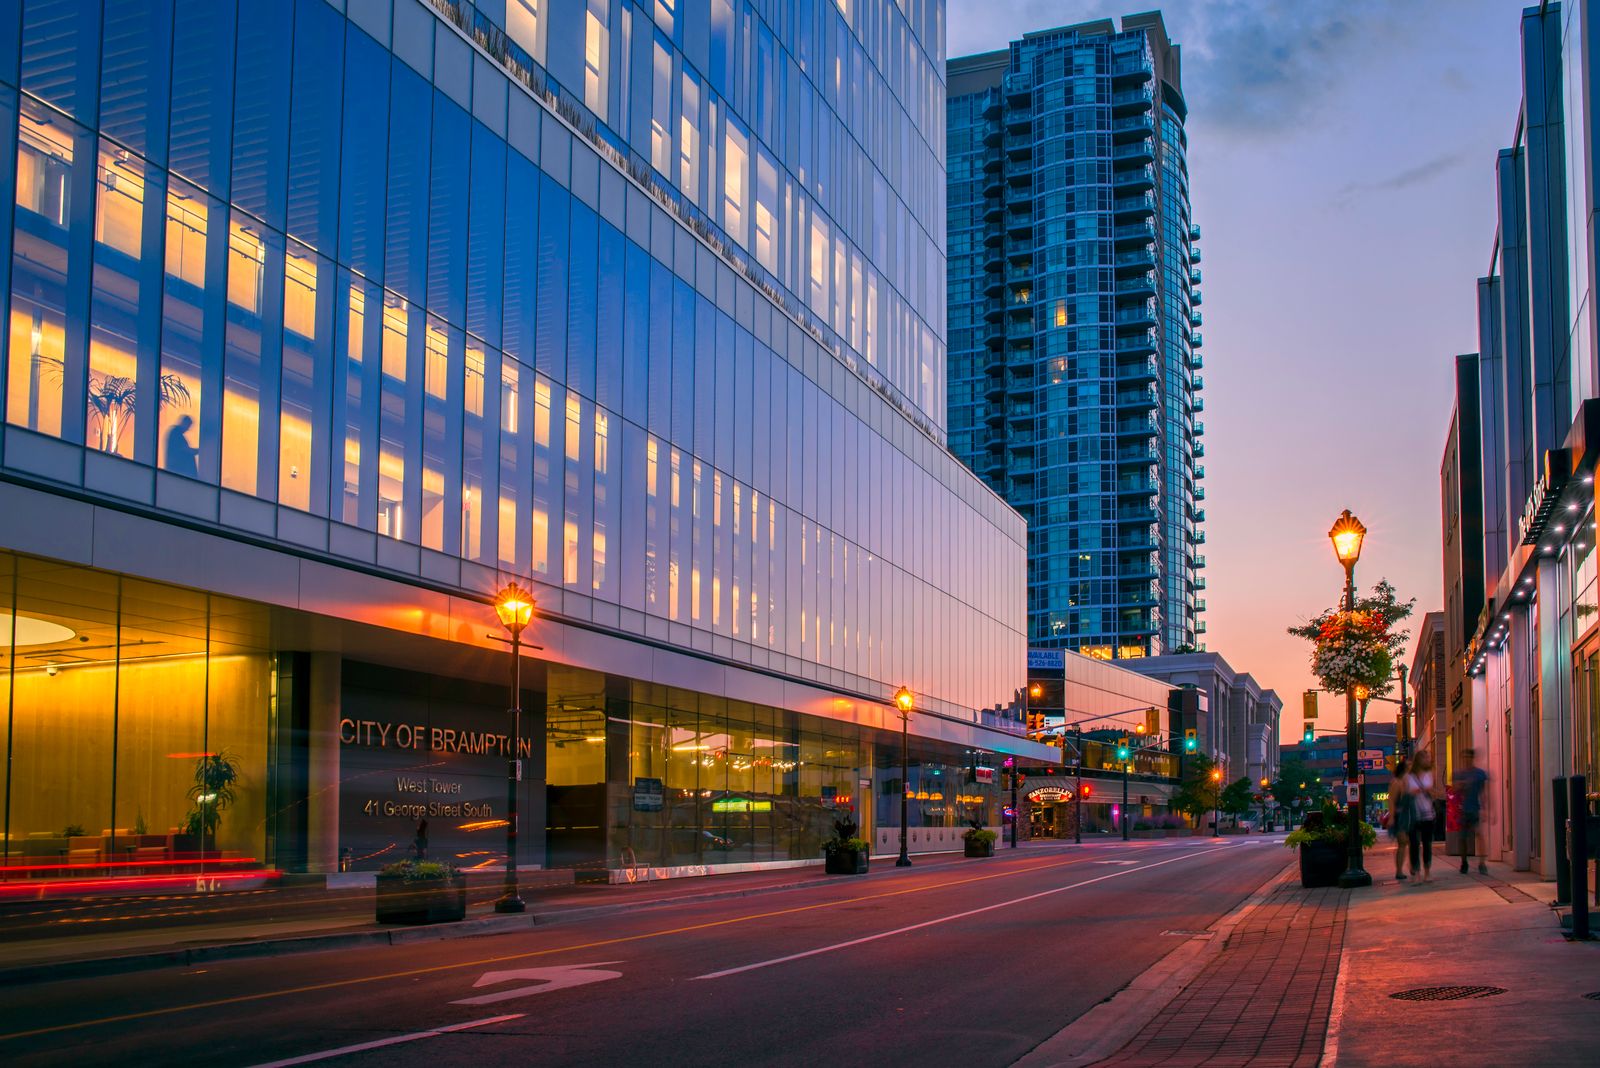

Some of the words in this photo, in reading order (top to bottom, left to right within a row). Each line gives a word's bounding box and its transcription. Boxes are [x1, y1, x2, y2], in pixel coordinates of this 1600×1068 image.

[1028, 651, 1059, 659] VAILABLE
[340, 718, 391, 747] CITY
[396, 724, 425, 749] OF
[397, 777, 427, 793] West
[429, 778, 462, 794] Tower
[364, 799, 379, 816] 41
[384, 800, 426, 820] George
[429, 801, 461, 817] Street
[463, 802, 492, 817] South
